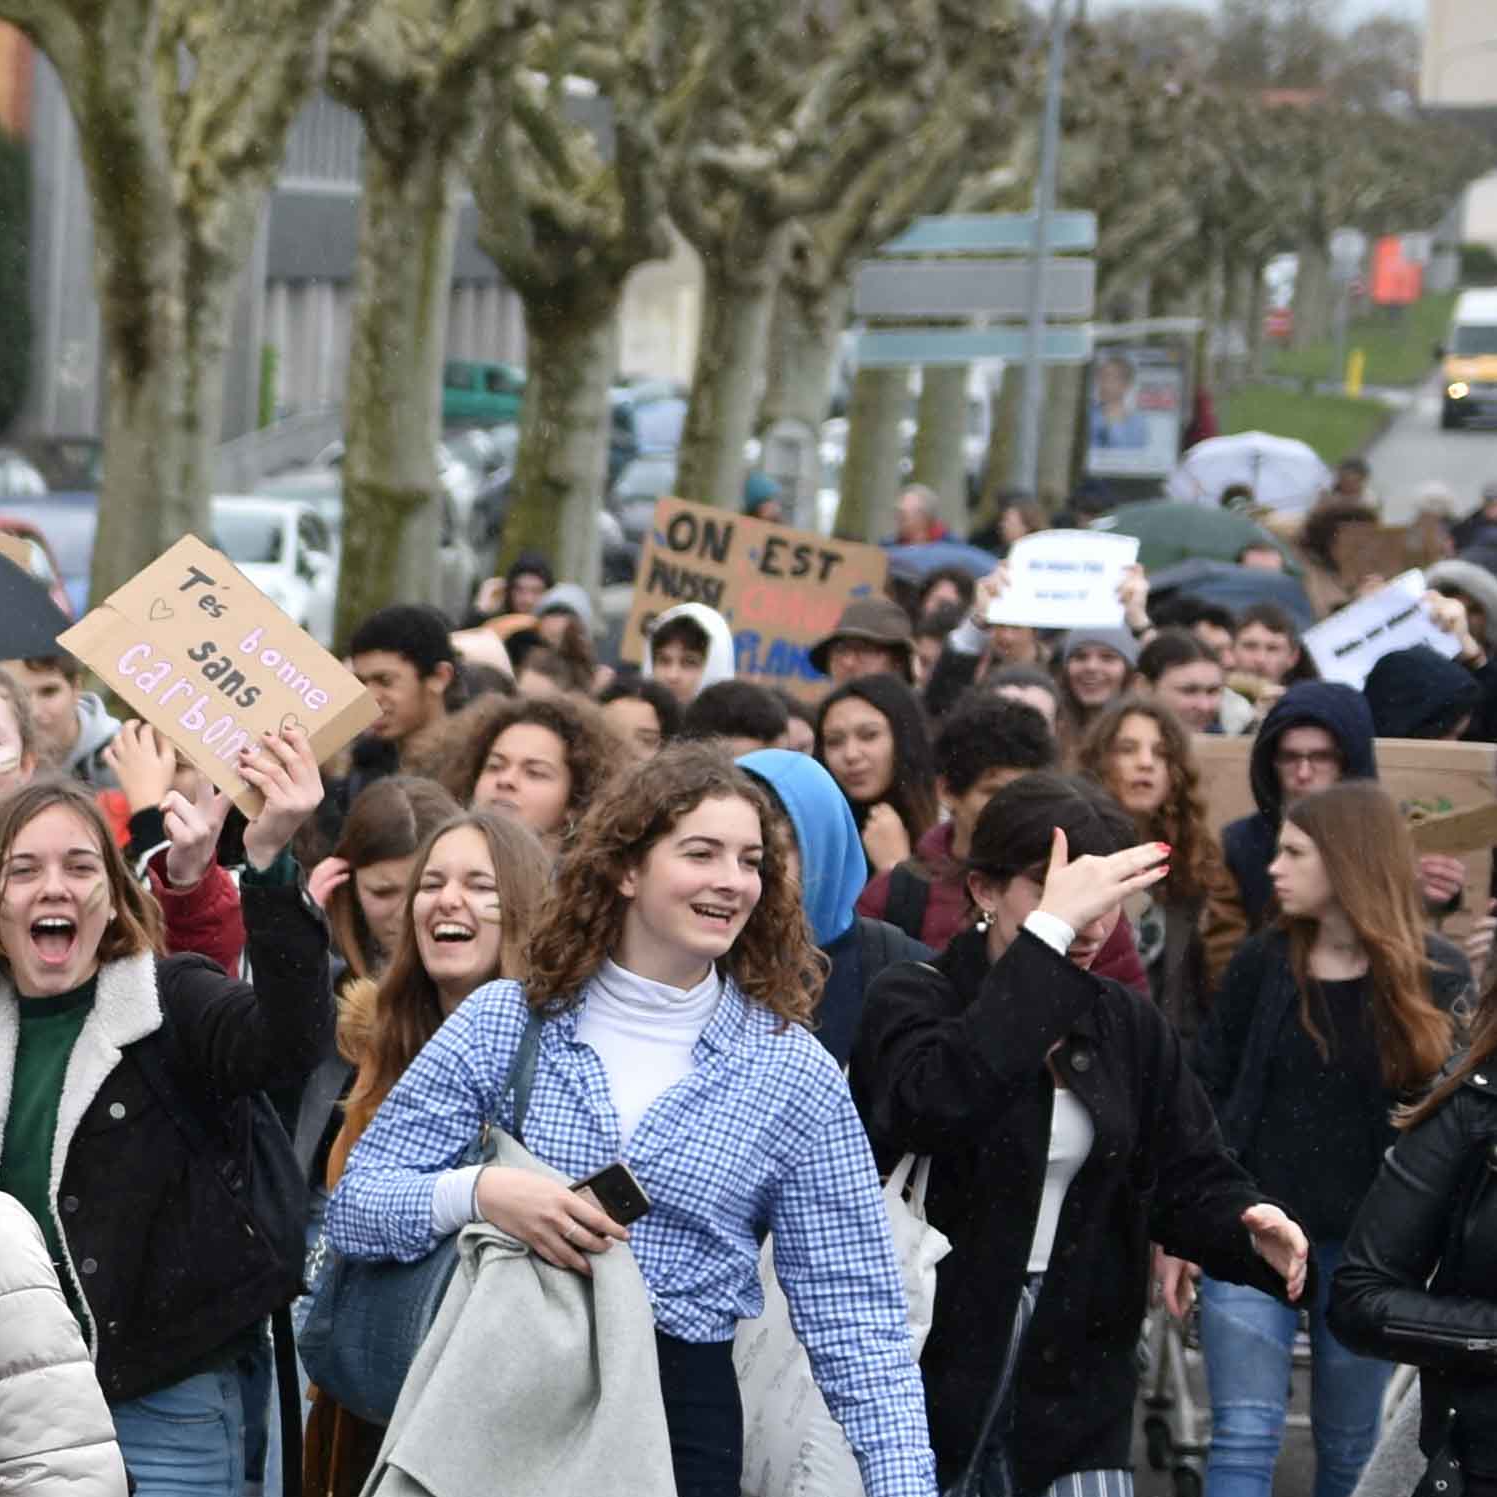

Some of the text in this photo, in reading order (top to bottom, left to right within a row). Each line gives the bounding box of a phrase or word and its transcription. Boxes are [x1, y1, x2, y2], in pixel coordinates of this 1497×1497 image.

[667, 511, 843, 582] ON EST
[187, 640, 263, 709] sans
[239, 627, 329, 711] bonne
